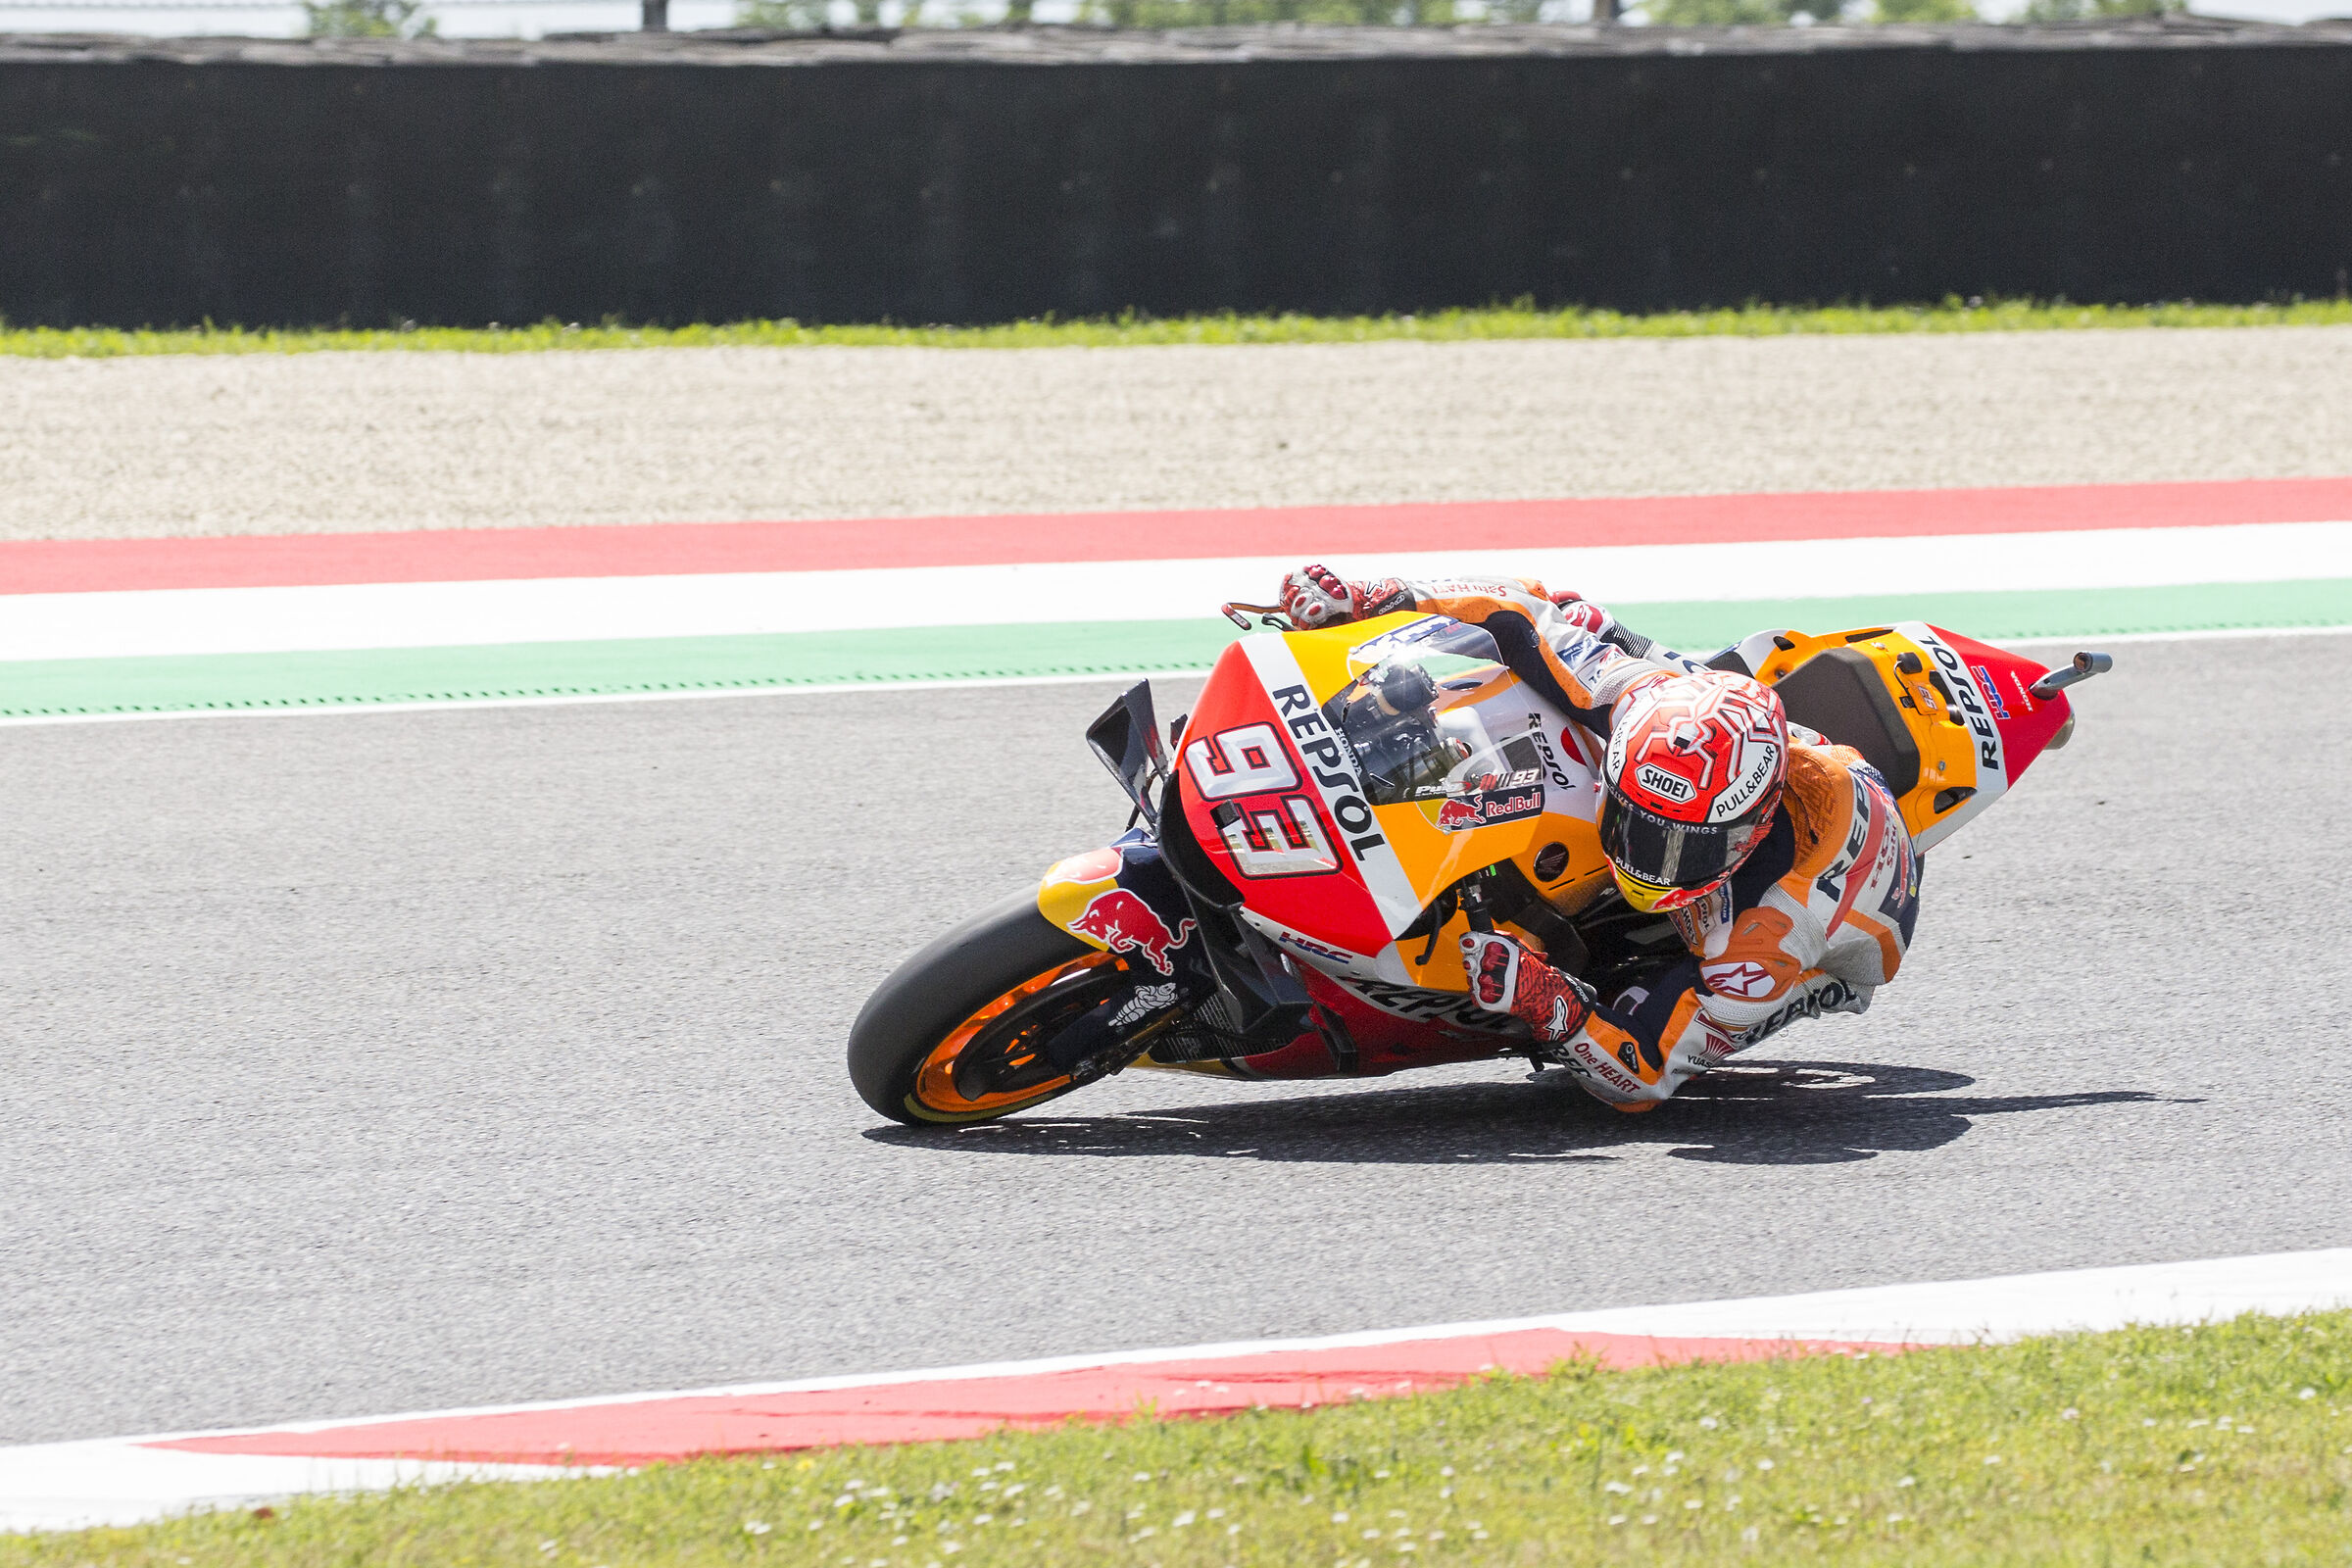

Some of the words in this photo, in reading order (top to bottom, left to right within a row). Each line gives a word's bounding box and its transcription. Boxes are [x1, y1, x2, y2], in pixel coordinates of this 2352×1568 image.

[1919, 635, 1999, 770] REPSOL
[1971, 664, 2011, 720] HRC
[2010, 670, 2034, 712] HONDA
[1272, 684, 1386, 861] REPSOL
[1334, 726, 1364, 777] HONDA
[1512, 768, 1540, 783] 93
[1528, 712, 1576, 791] REPSOL
[1184, 721, 1344, 880] 93
[1486, 799, 1514, 817] Red
[1514, 792, 1542, 812] Bull
[1642, 768, 1689, 799] SHOEI
[1716, 745, 1775, 816] PULL&BEAR
[1608, 785, 1635, 811] GIVES
[1640, 809, 1665, 827] YOU
[1672, 821, 1718, 835] WINGS
[1615, 857, 1671, 886] PULL&BEAR
[1278, 931, 1353, 964] HRC
[1574, 1042, 1597, 1065] One
[1593, 1061, 1642, 1094] HEART
